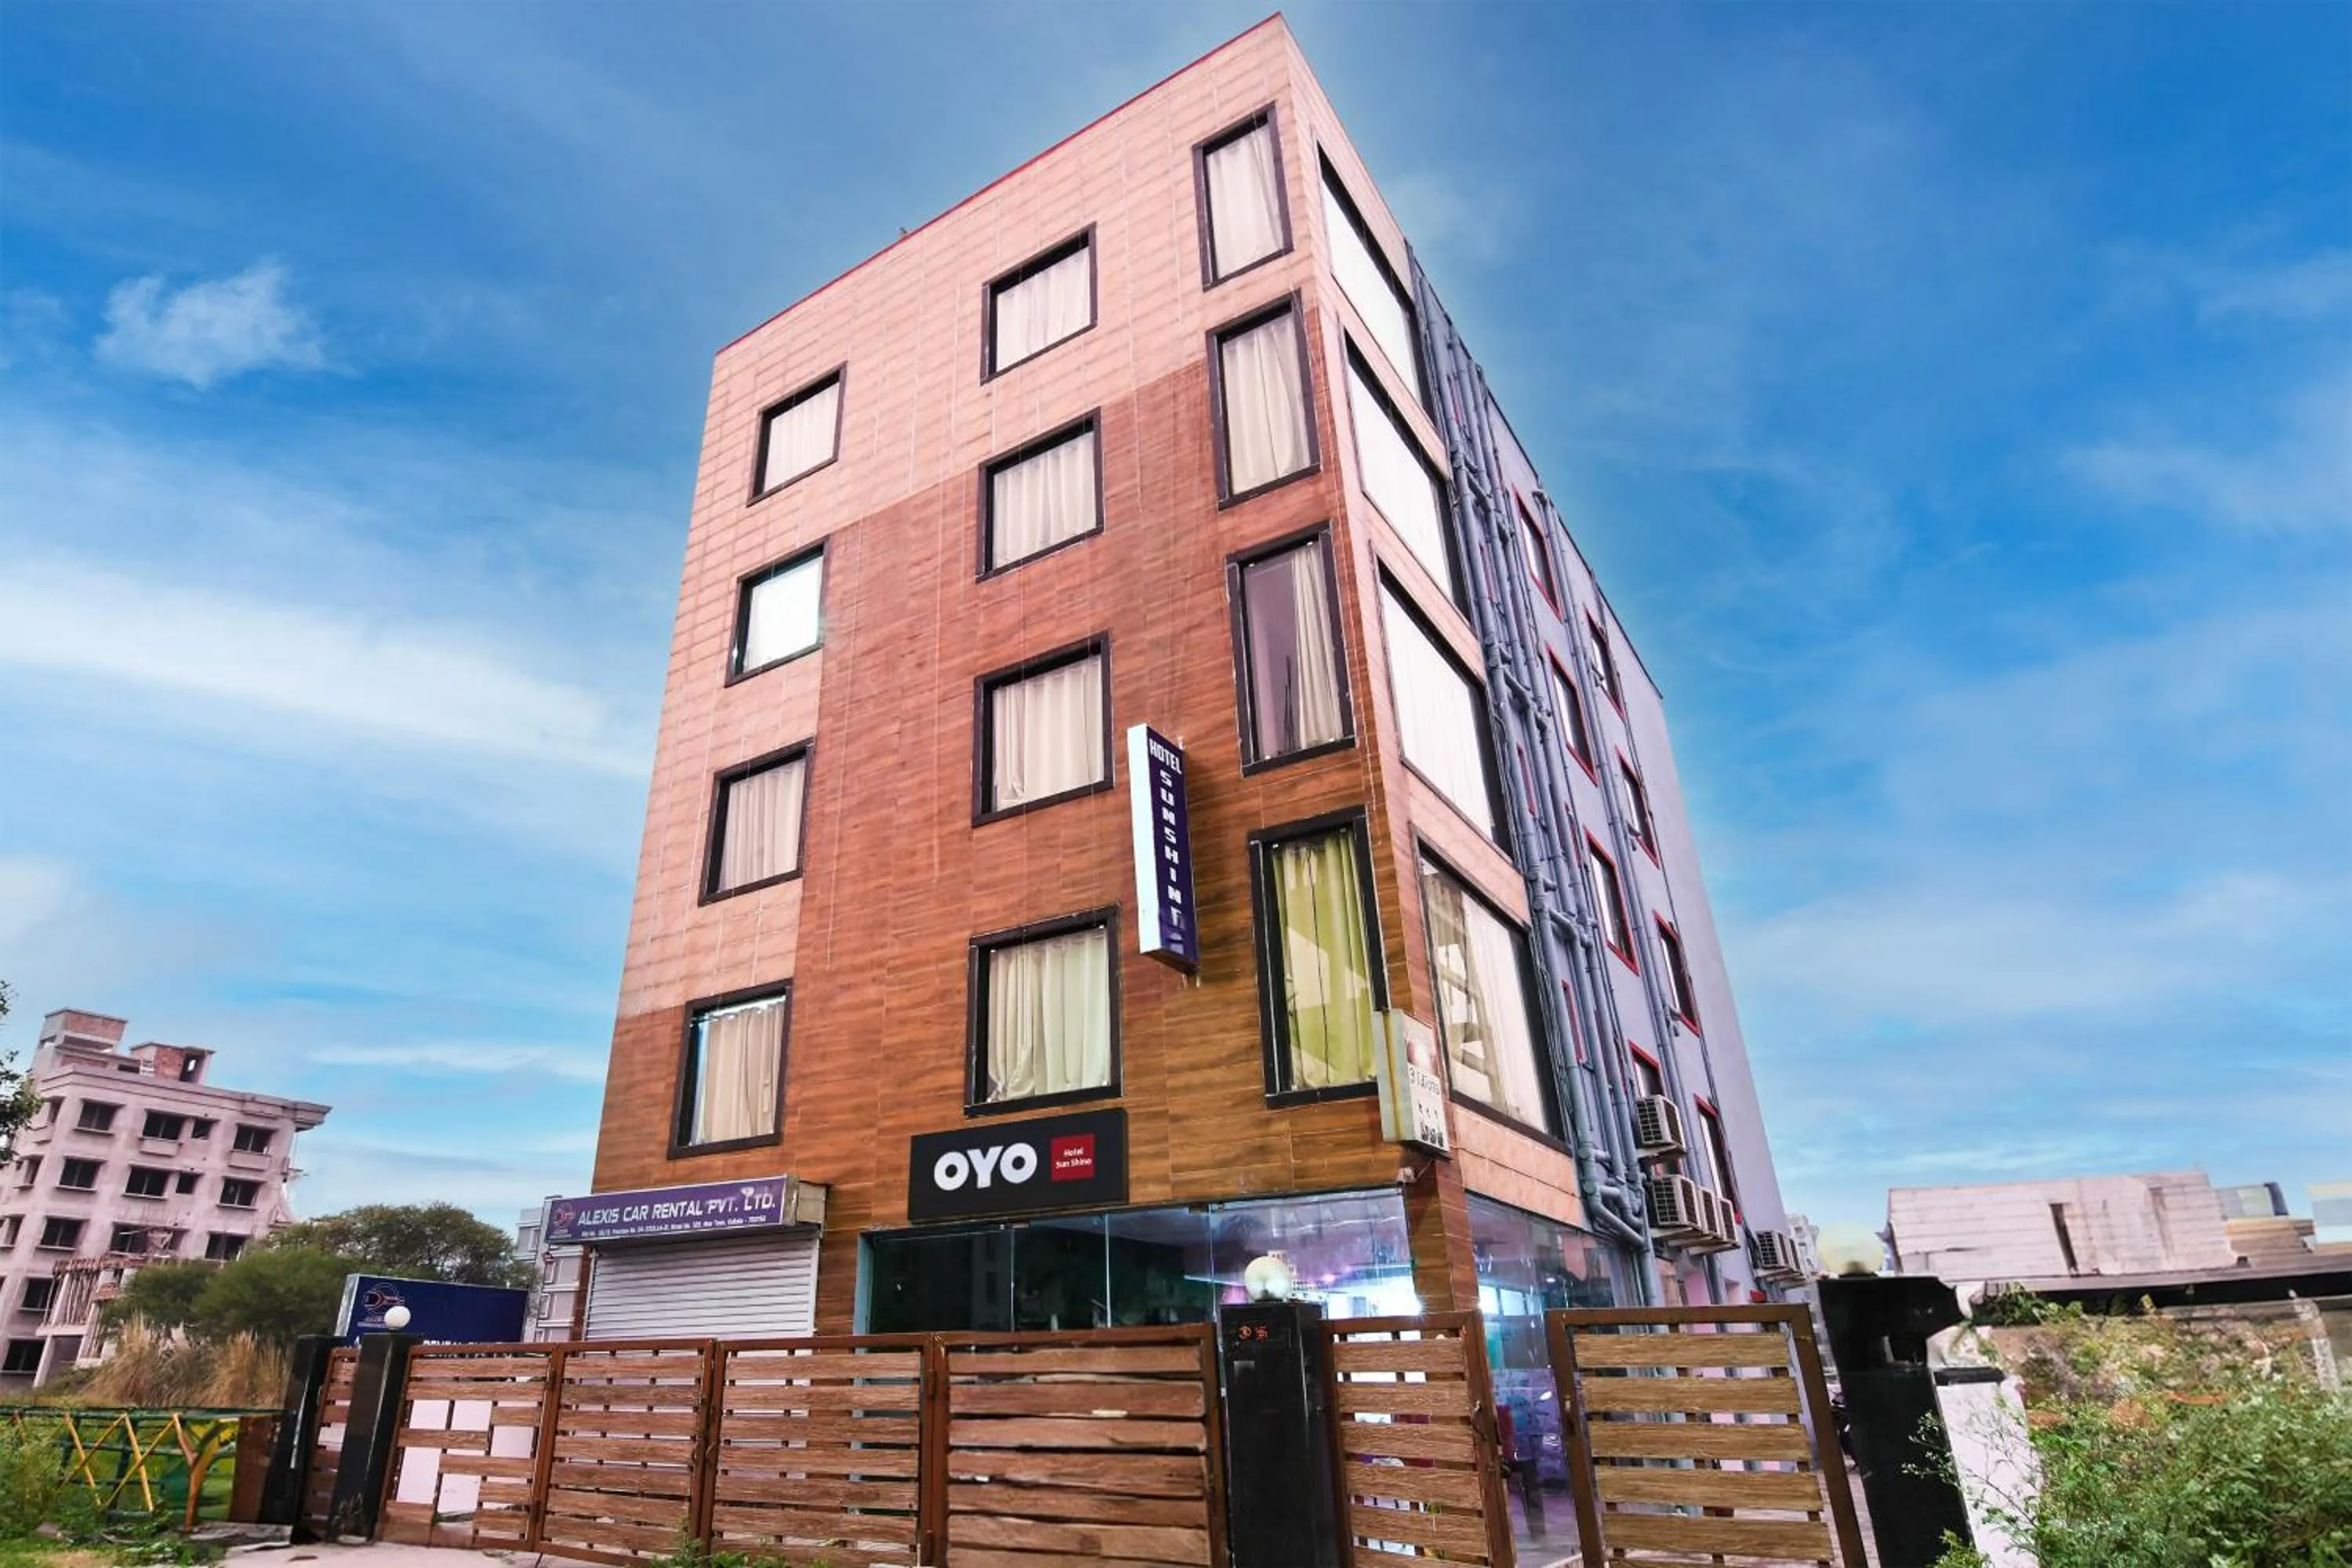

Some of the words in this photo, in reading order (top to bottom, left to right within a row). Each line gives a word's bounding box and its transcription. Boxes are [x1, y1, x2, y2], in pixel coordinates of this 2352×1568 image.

[1149, 738, 1183, 775] HOTEL
[934, 1142, 1038, 1191] OYO
[1063, 1147, 1084, 1156] Hotel
[1071, 1158, 1092, 1167] Shine
[577, 1207, 619, 1225] ALEXIS
[623, 1204, 649, 1222] CAR
[652, 1200, 703, 1219] RENTAL
[707, 1196, 739, 1214] PVT.
[743, 1192, 775, 1210] LTD.
